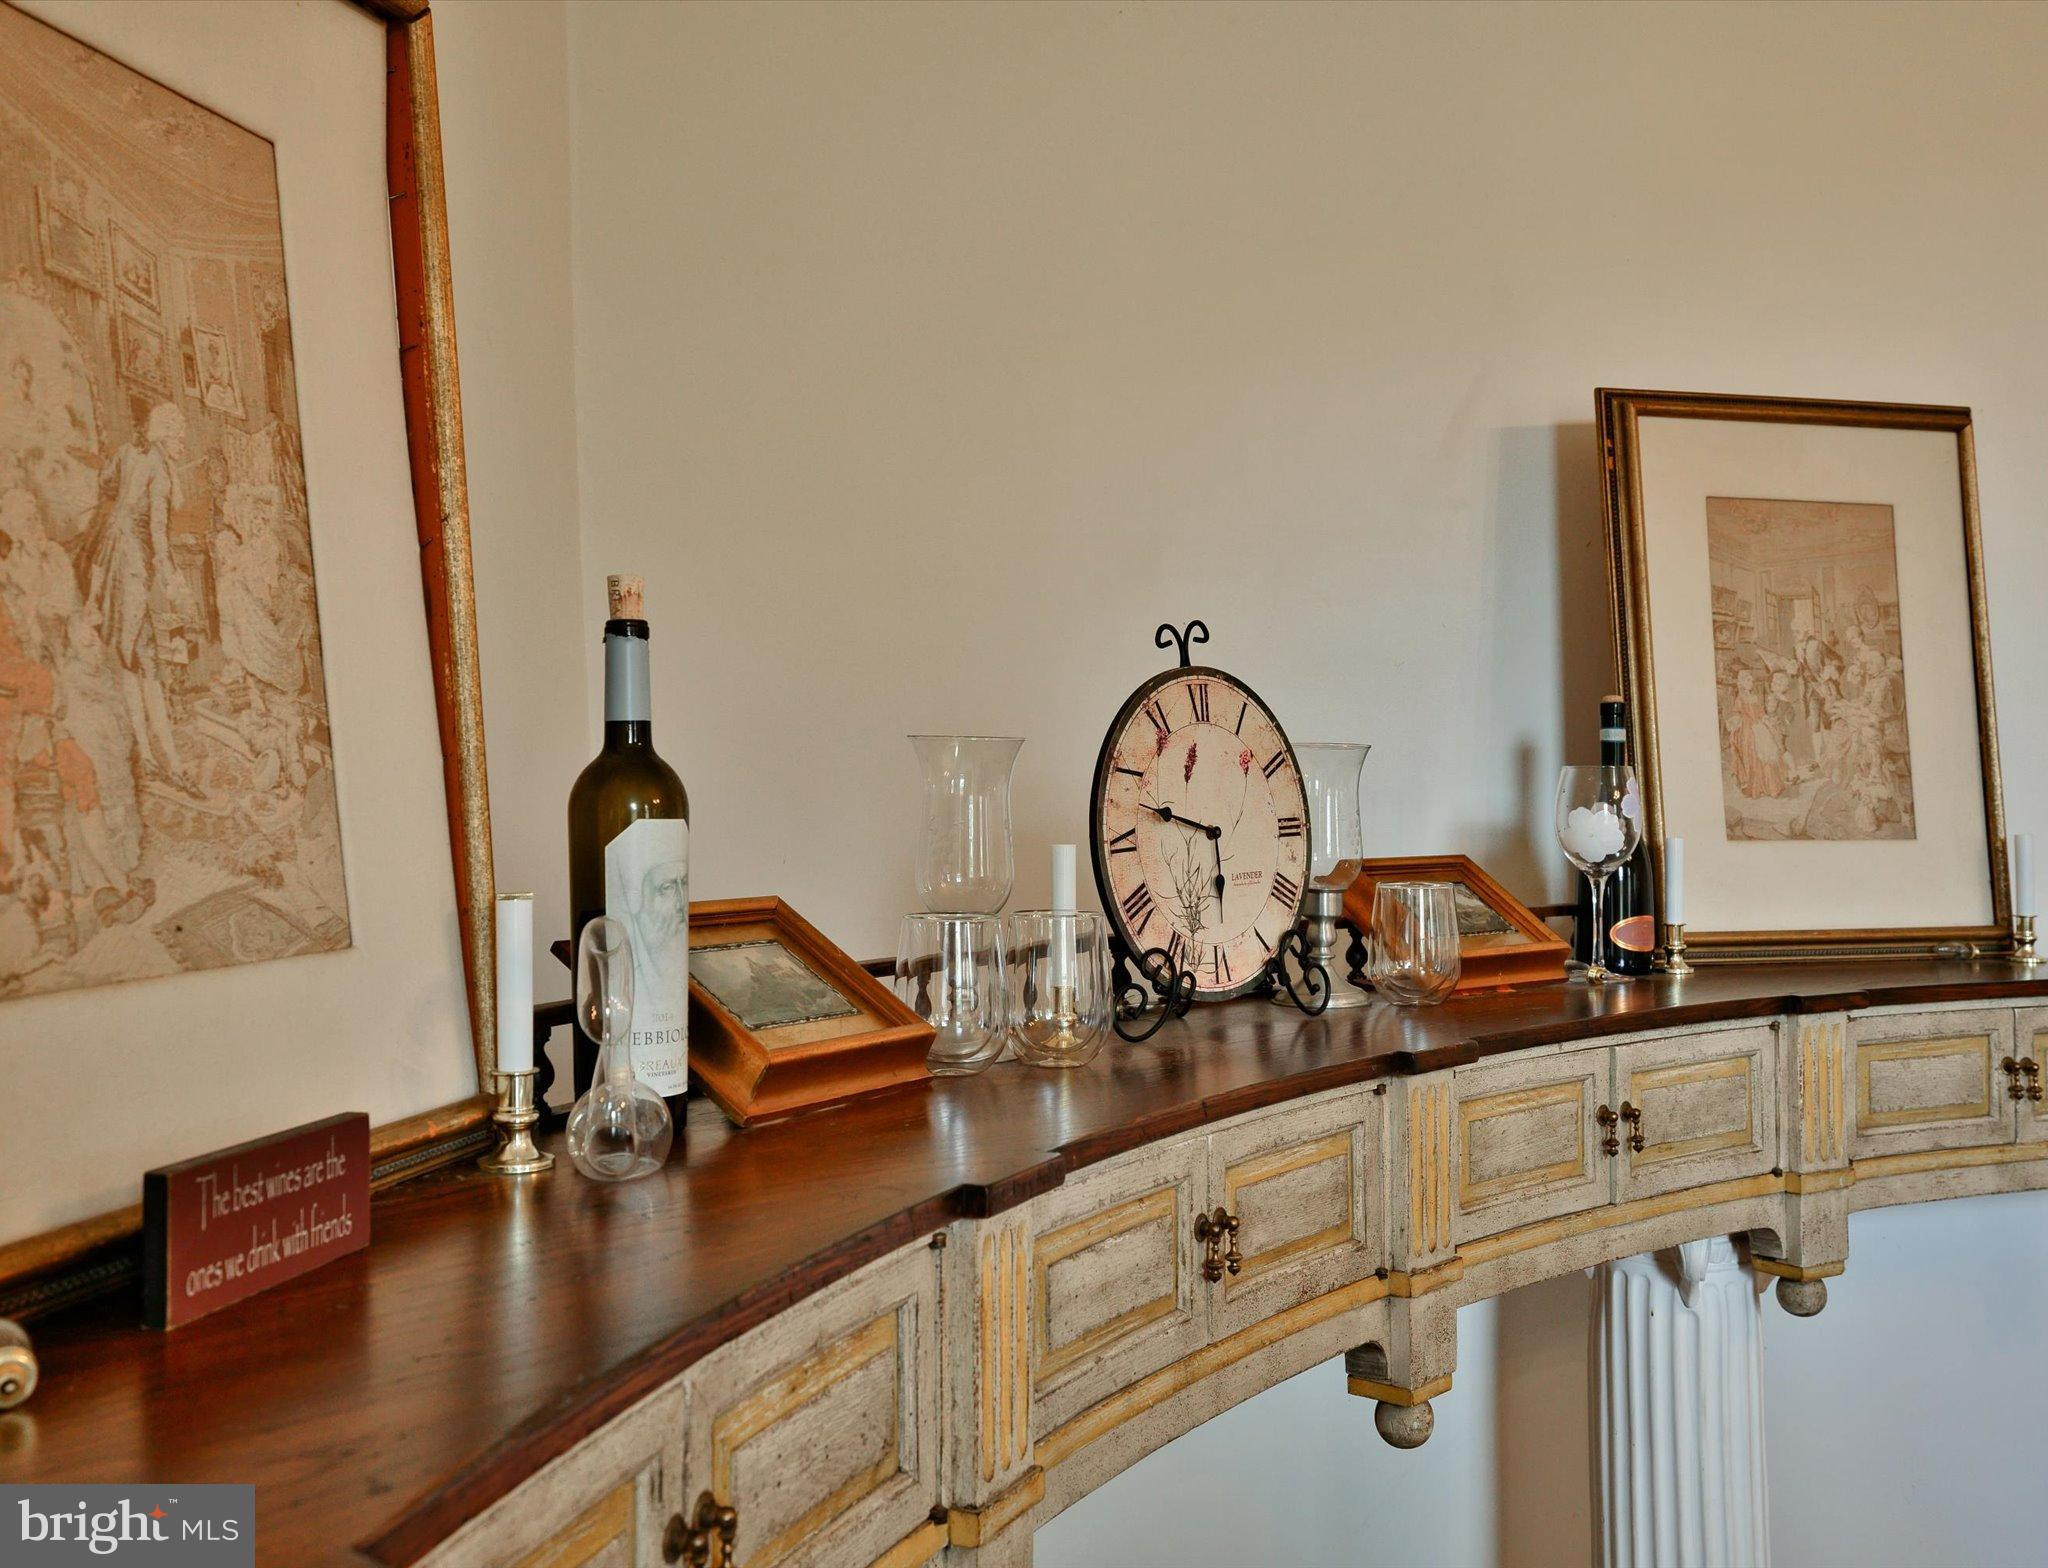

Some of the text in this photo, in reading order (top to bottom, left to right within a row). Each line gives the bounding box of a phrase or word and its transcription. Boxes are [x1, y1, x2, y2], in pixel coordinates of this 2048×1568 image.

[1186, 683, 1211, 723] XII
[1235, 701, 1248, 736] I
[1262, 749, 1287, 780] II
[1276, 815, 1302, 838] III
[1231, 871, 1263, 881] LAVENDER
[1270, 870, 1299, 912] IIII
[632, 1027, 688, 1046] EBBIOL
[196, 1135, 346, 1231] The best wines are the
[185, 1193, 353, 1297] ones we drink with friends
